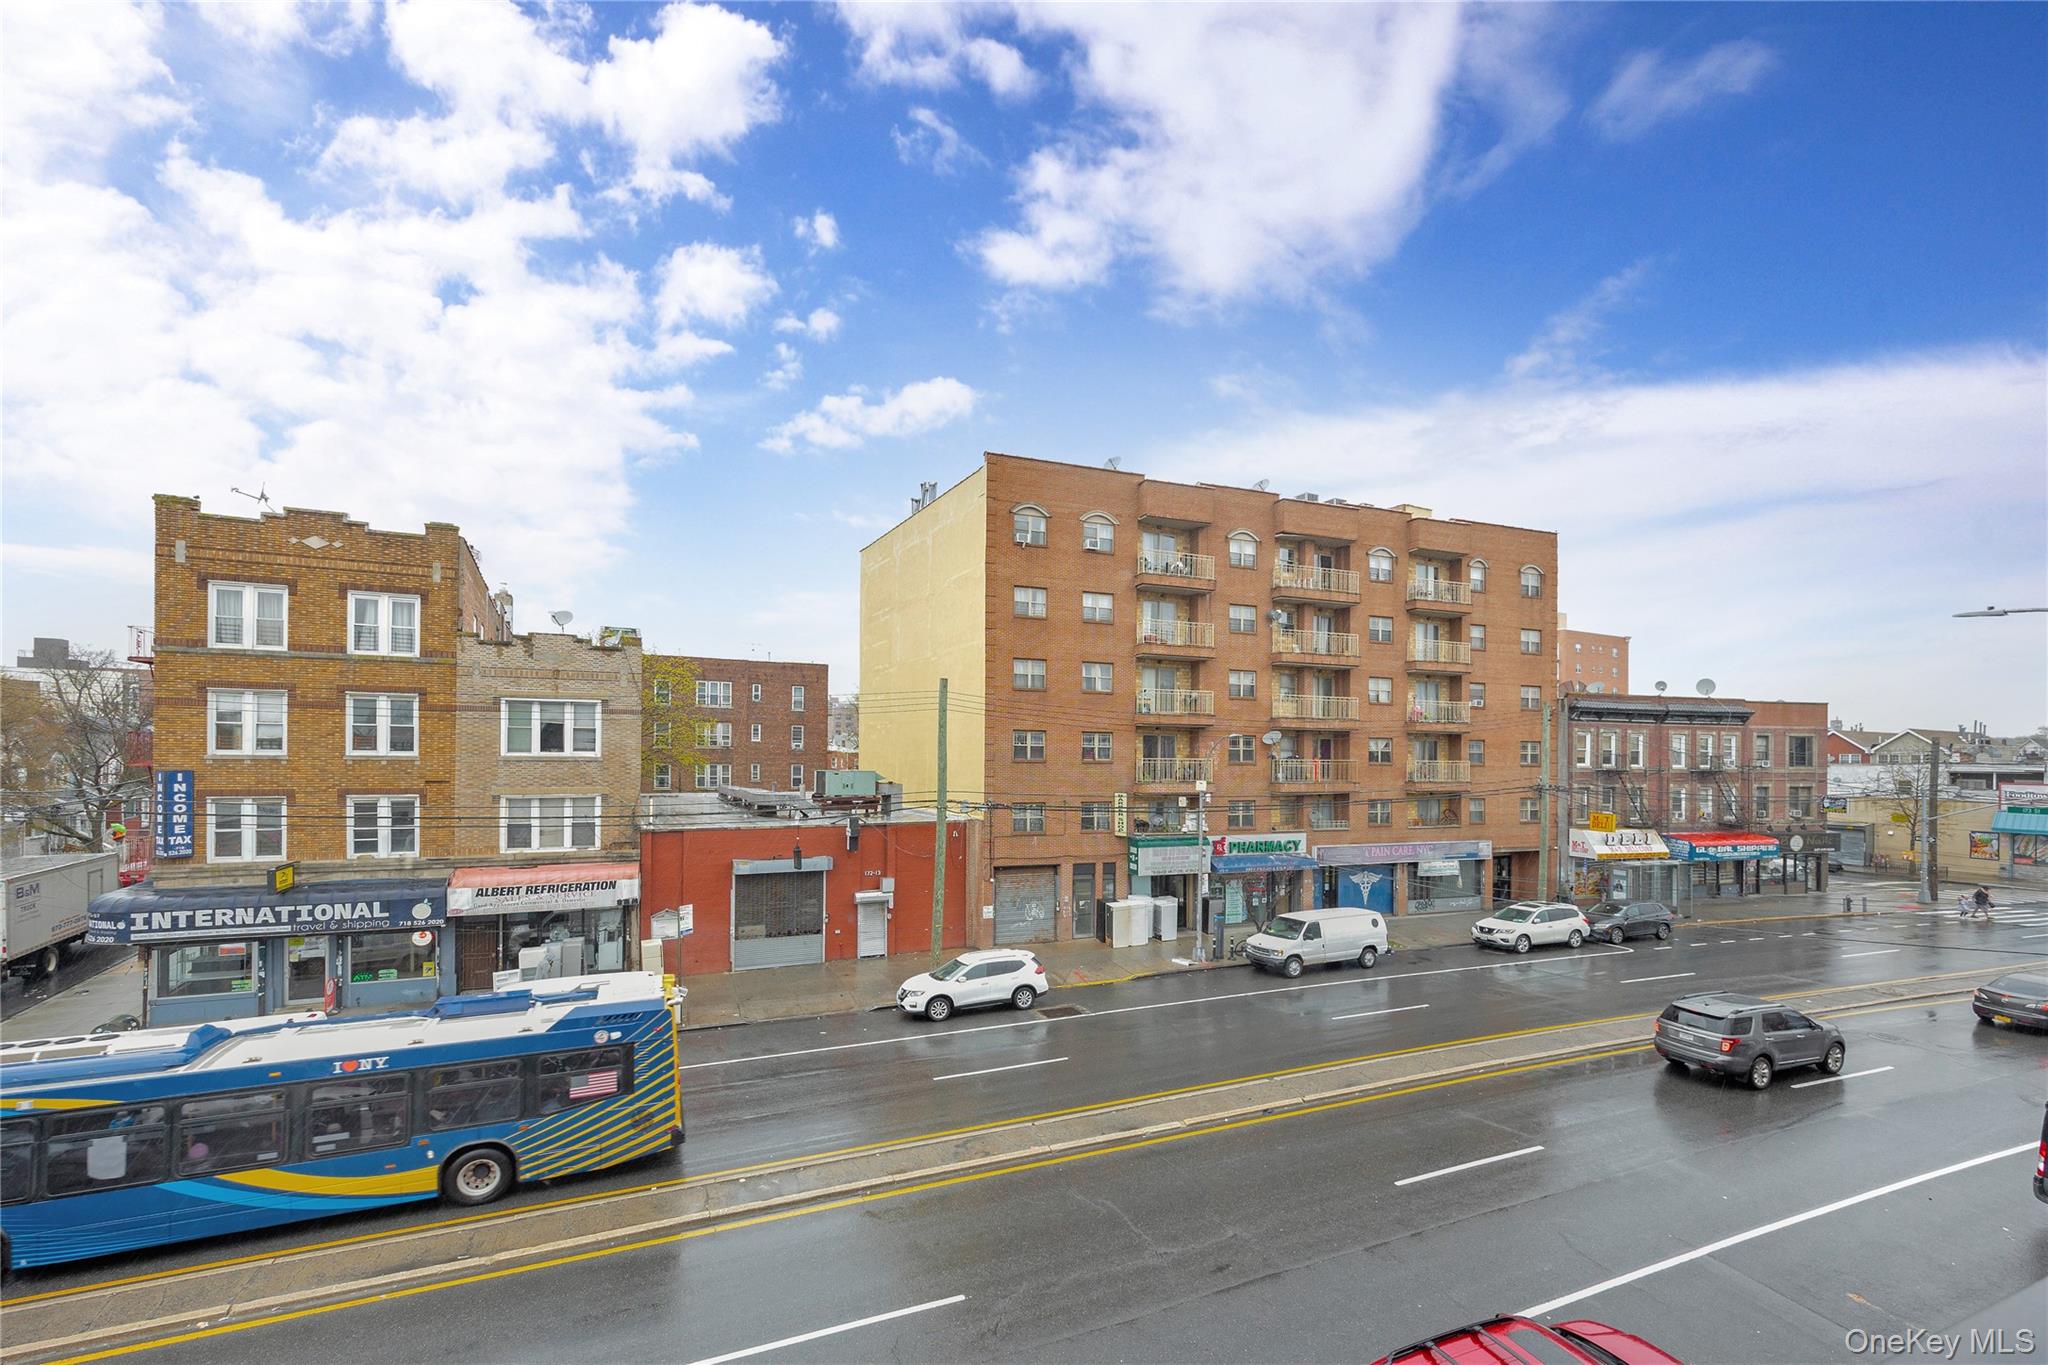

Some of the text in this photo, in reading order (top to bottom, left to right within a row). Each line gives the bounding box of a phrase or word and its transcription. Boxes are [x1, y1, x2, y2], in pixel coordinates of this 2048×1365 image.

[173, 772, 188, 834] INCOME
[168, 835, 192, 846] TAX
[1605, 832, 1653, 846] DELI
[1229, 840, 1302, 854] PHARMACY
[1371, 844, 1434, 857] PAIN CARE NYC
[1737, 844, 1777, 852] SHIPPING
[475, 880, 617, 898] ALBERT REFRIGERATION
[550, 890, 597, 899] SERVICE
[20, 903, 36, 912] TRUCK
[130, 901, 389, 931] INTERNATIONAL
[293, 921, 326, 932] travel
[330, 920, 339, 930] &
[342, 919, 390, 930] shipping
[96, 935, 115, 944] 2020
[333, 1056, 390, 1074] I NY
